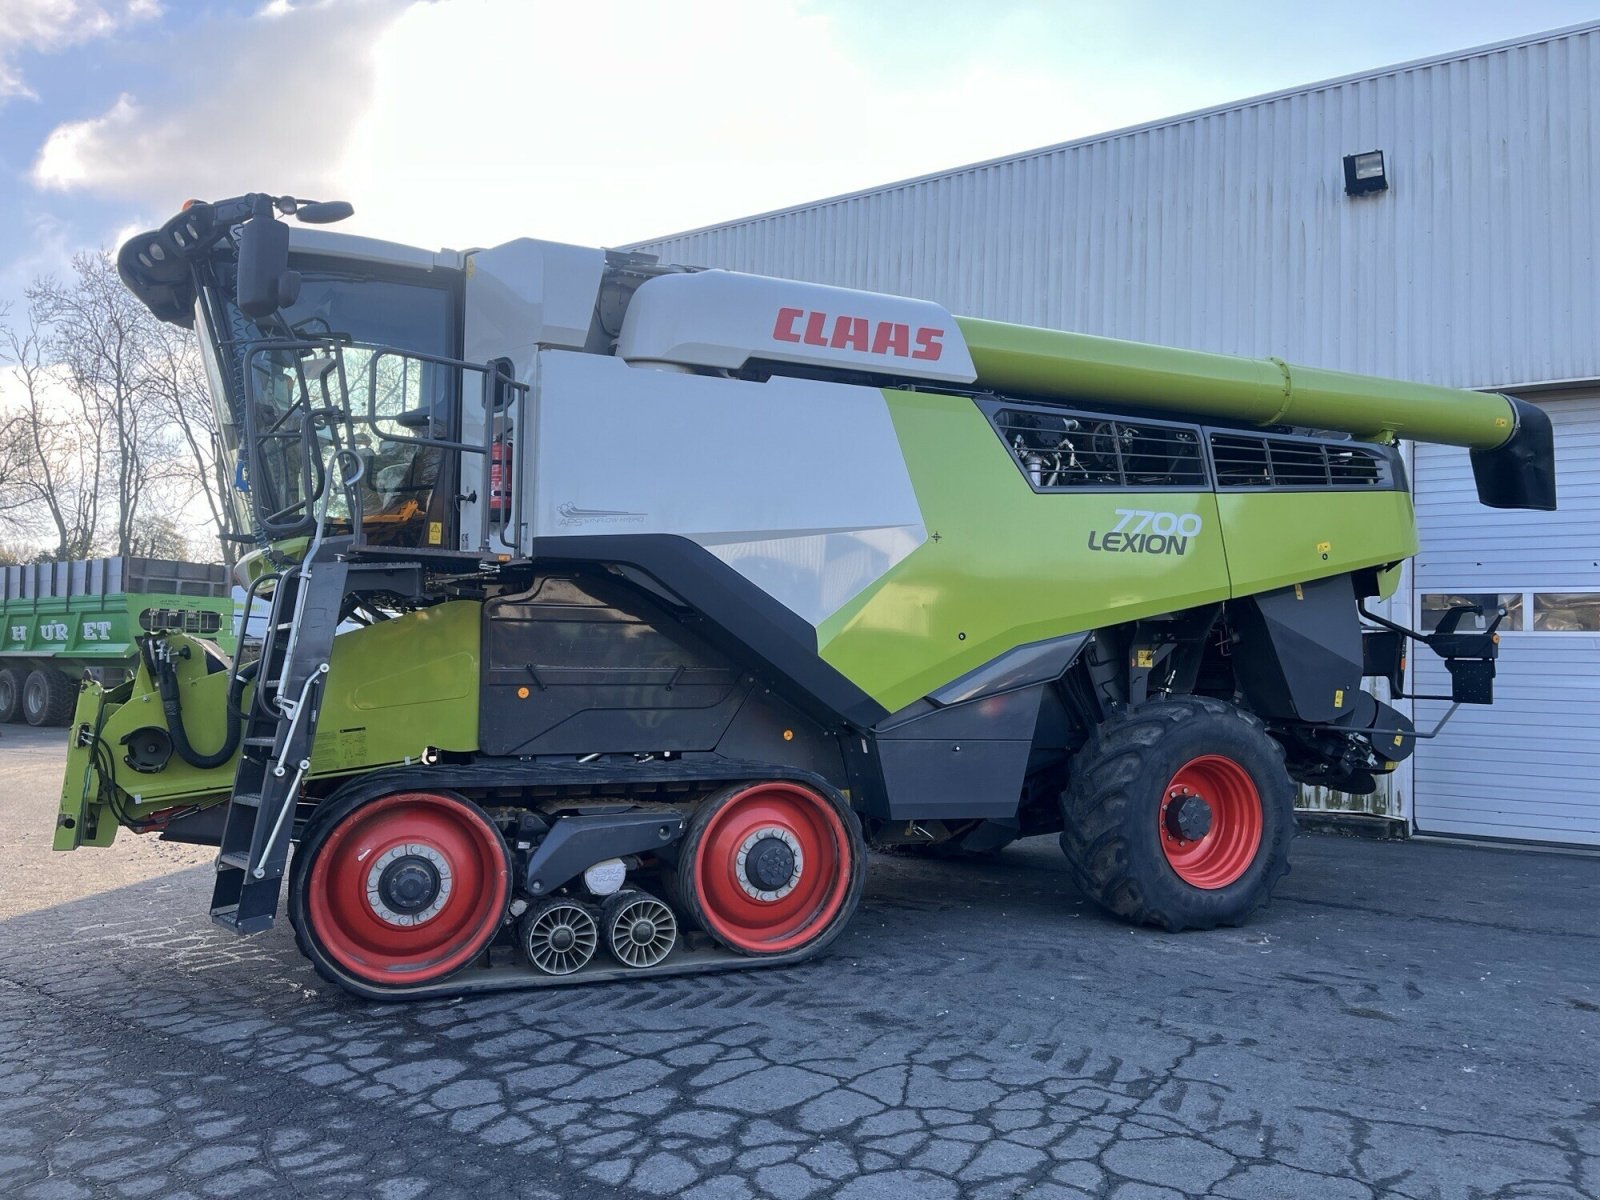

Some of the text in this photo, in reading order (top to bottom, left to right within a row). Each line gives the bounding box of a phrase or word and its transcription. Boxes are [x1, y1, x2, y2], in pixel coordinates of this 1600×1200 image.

[772, 307, 945, 361] CLAAS
[1113, 508, 1203, 537] 7700
[1087, 530, 1188, 556] LEXION
